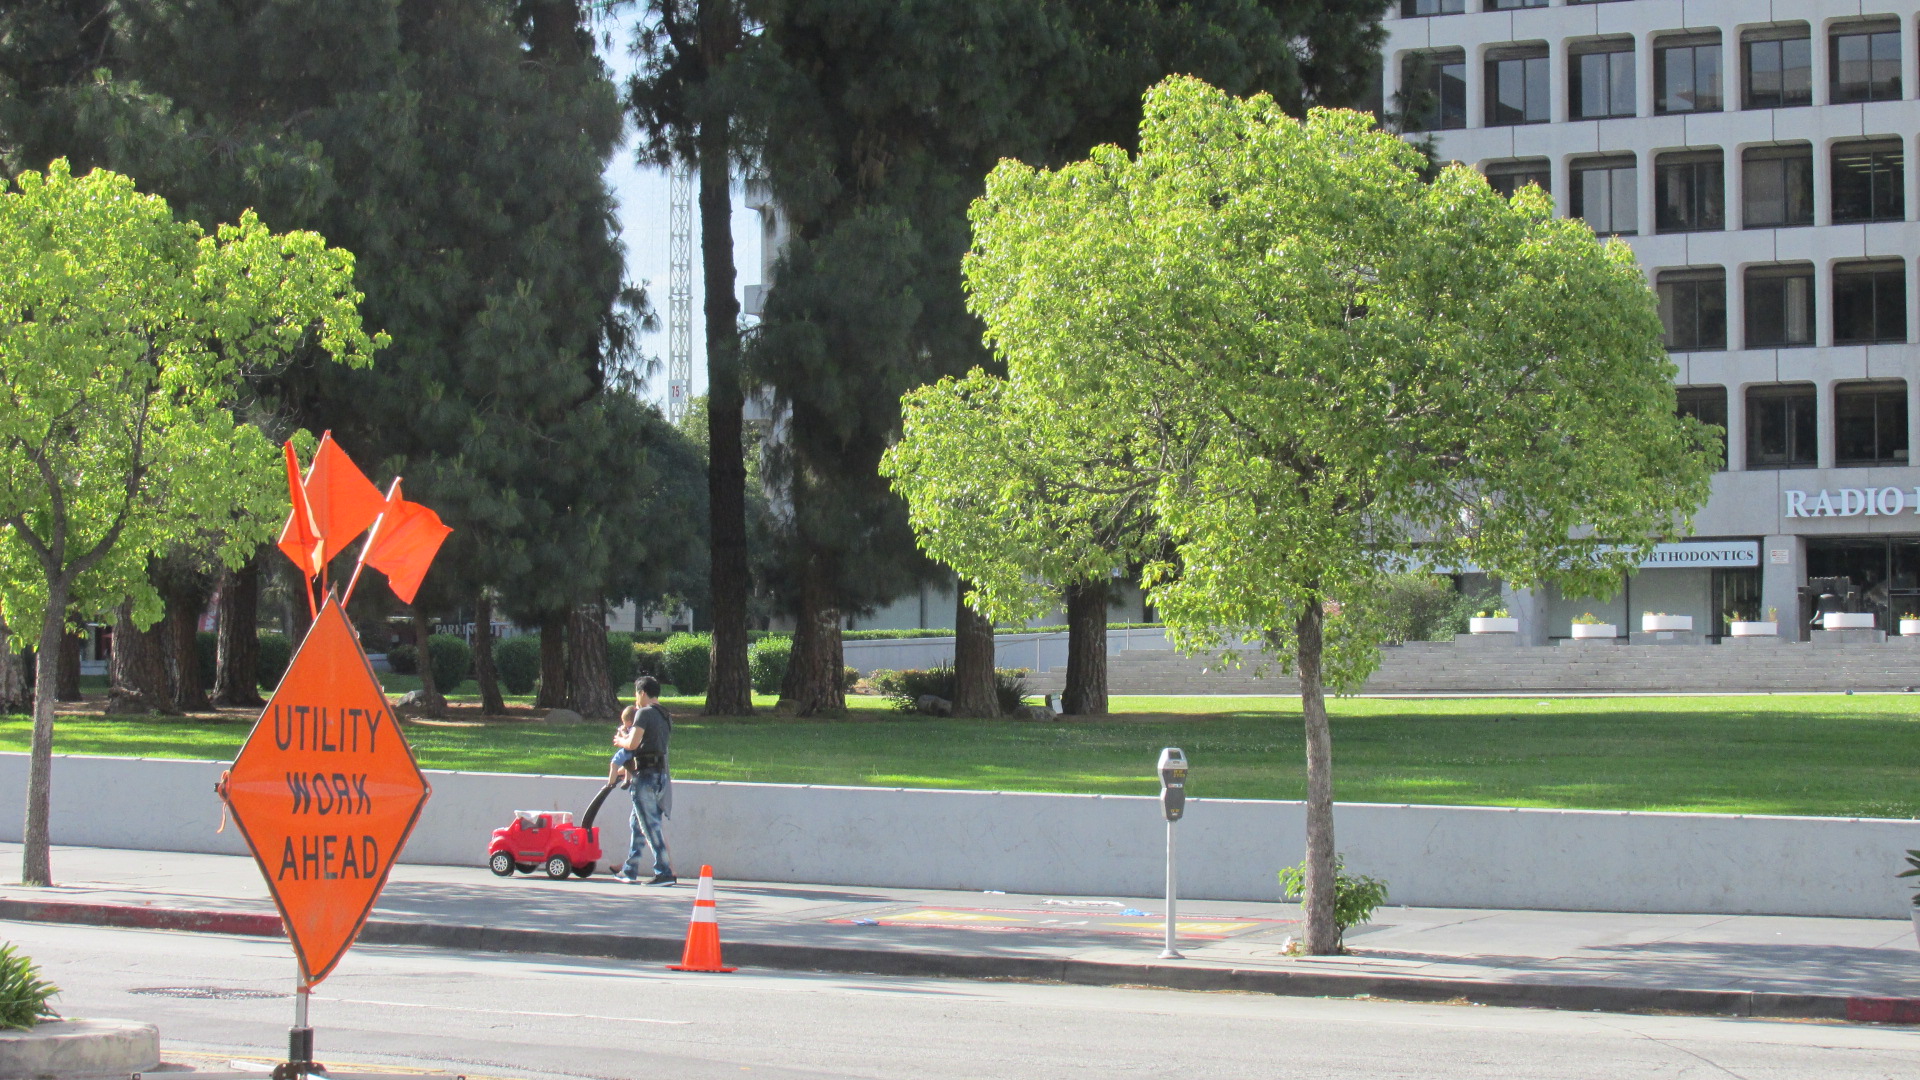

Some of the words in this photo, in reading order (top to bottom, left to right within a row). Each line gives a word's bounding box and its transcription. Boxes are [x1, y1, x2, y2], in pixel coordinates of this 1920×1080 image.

[671, 385, 680, 398] 75
[1784, 486, 1905, 518] RADIO
[435, 622, 479, 635] PARKIN
[274, 704, 383, 753] UTILITY
[285, 771, 373, 816] WORK
[277, 835, 380, 881] AHEAD
